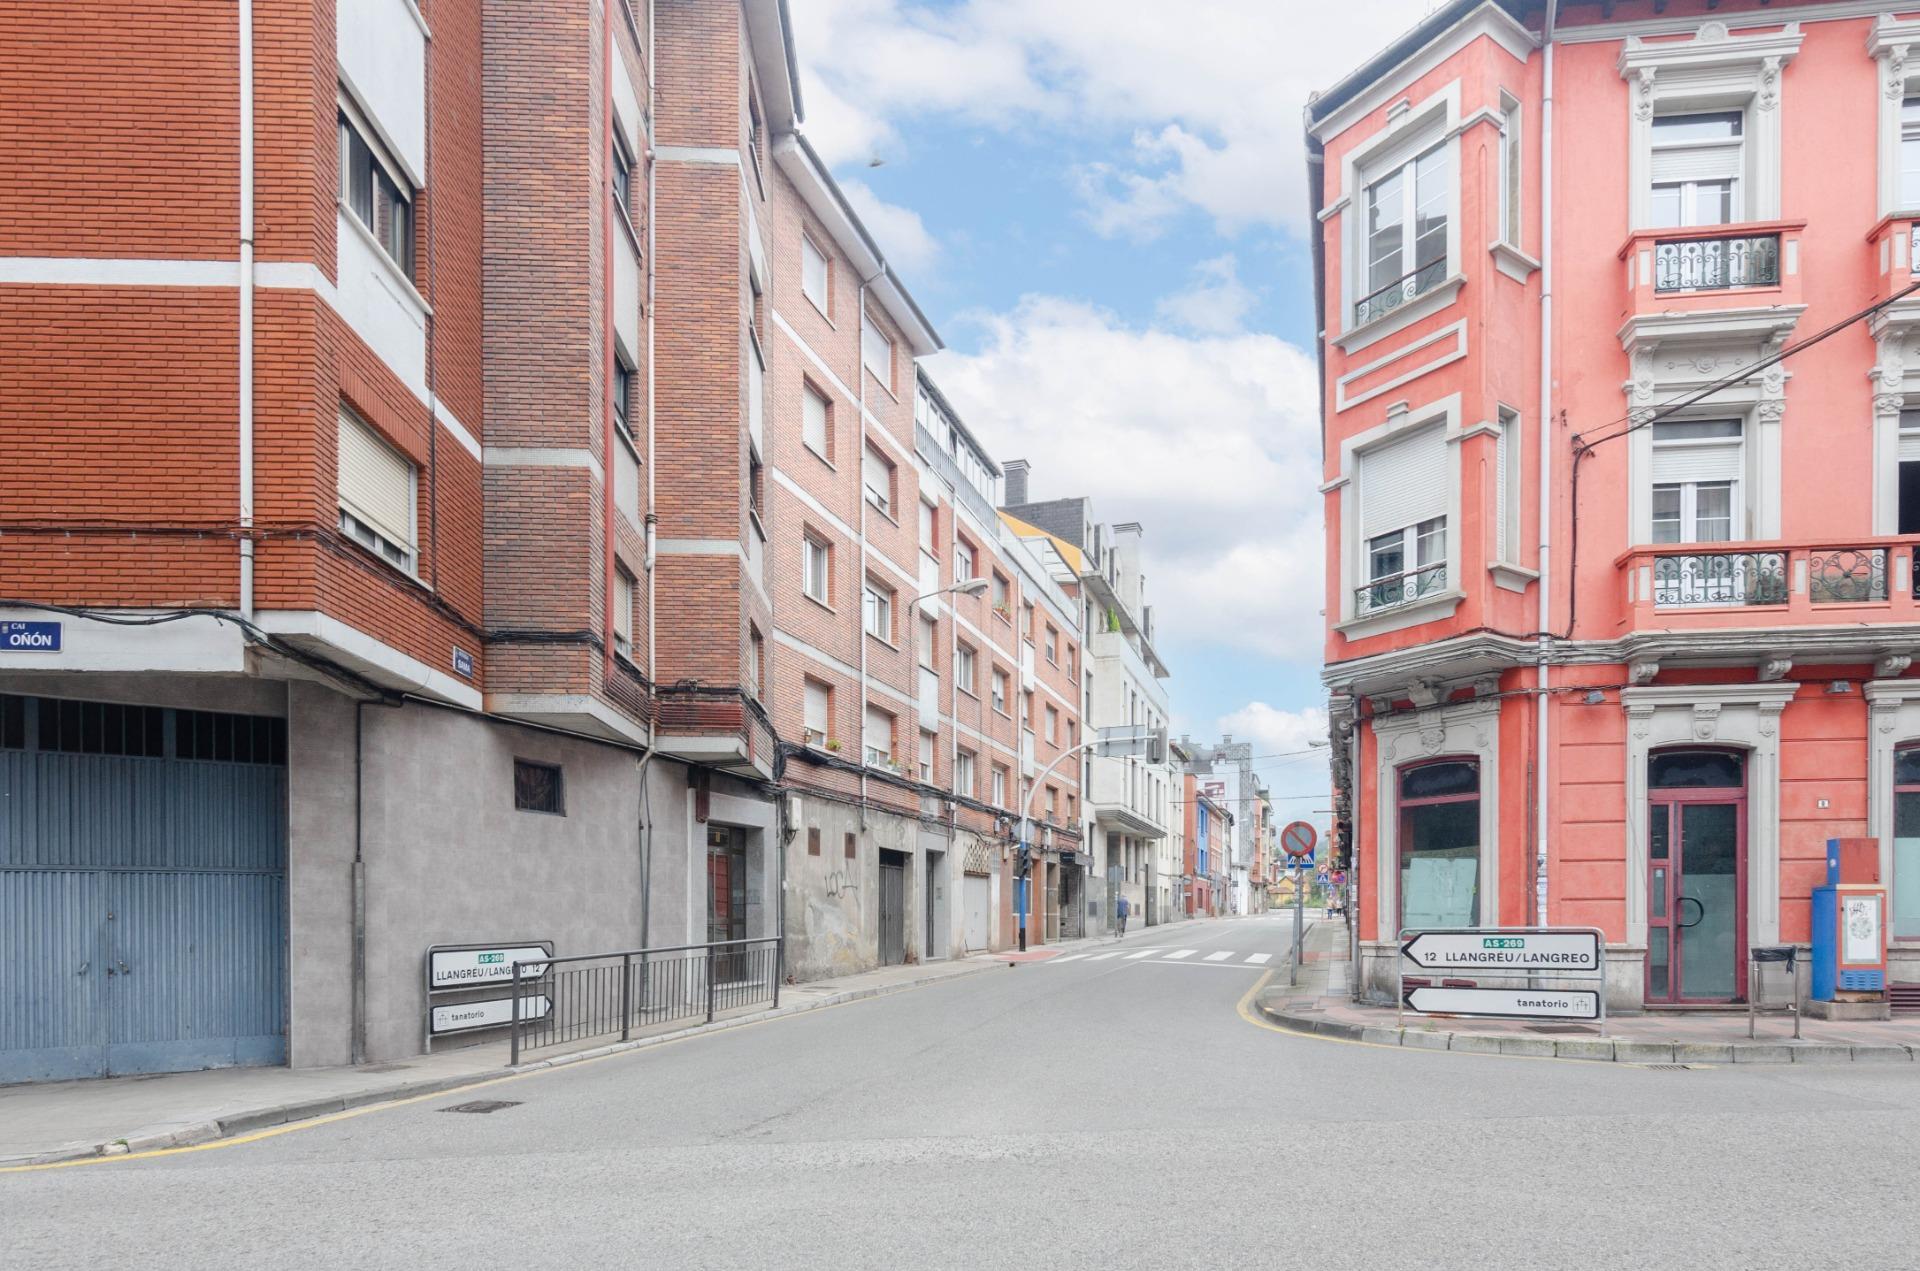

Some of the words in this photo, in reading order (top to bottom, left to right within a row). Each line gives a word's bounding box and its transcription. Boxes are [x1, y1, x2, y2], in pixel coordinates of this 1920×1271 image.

[10, 632, 52, 646] OÑÓN
[1484, 939, 1524, 948] AS-269
[1424, 952, 1437, 961] 12
[1445, 951, 1590, 963] LLANGRÉU/LANGREO
[436, 963, 527, 981] LLANGRÉU/LANGO
[532, 963, 541, 974] 12
[1517, 999, 1569, 1009] tanatorio
[451, 1011, 485, 1021] tanatorio
